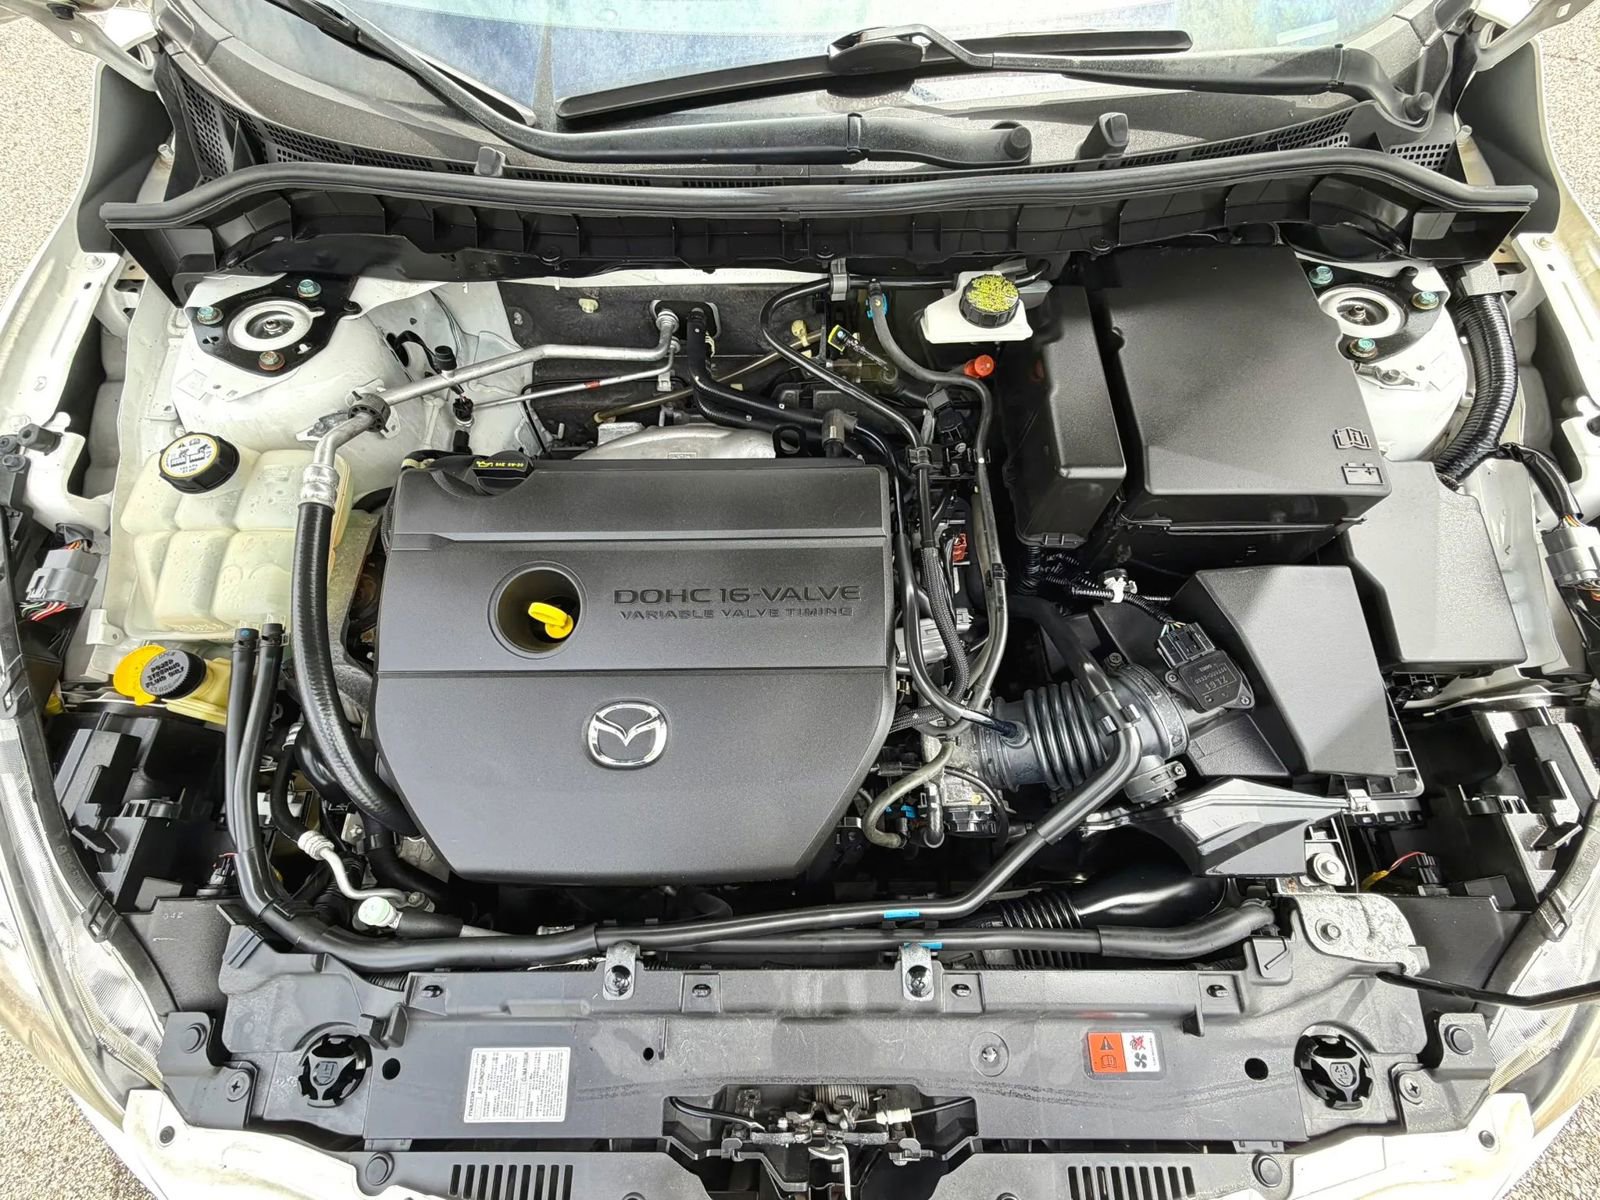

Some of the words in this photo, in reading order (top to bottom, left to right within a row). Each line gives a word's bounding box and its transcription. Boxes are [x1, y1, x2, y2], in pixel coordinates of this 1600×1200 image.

[613, 588, 711, 605] DOHC
[719, 585, 862, 604] 16-VALVE
[619, 609, 715, 620] VARIABLE
[721, 608, 780, 618] VALVE
[785, 607, 855, 617] TIMING
